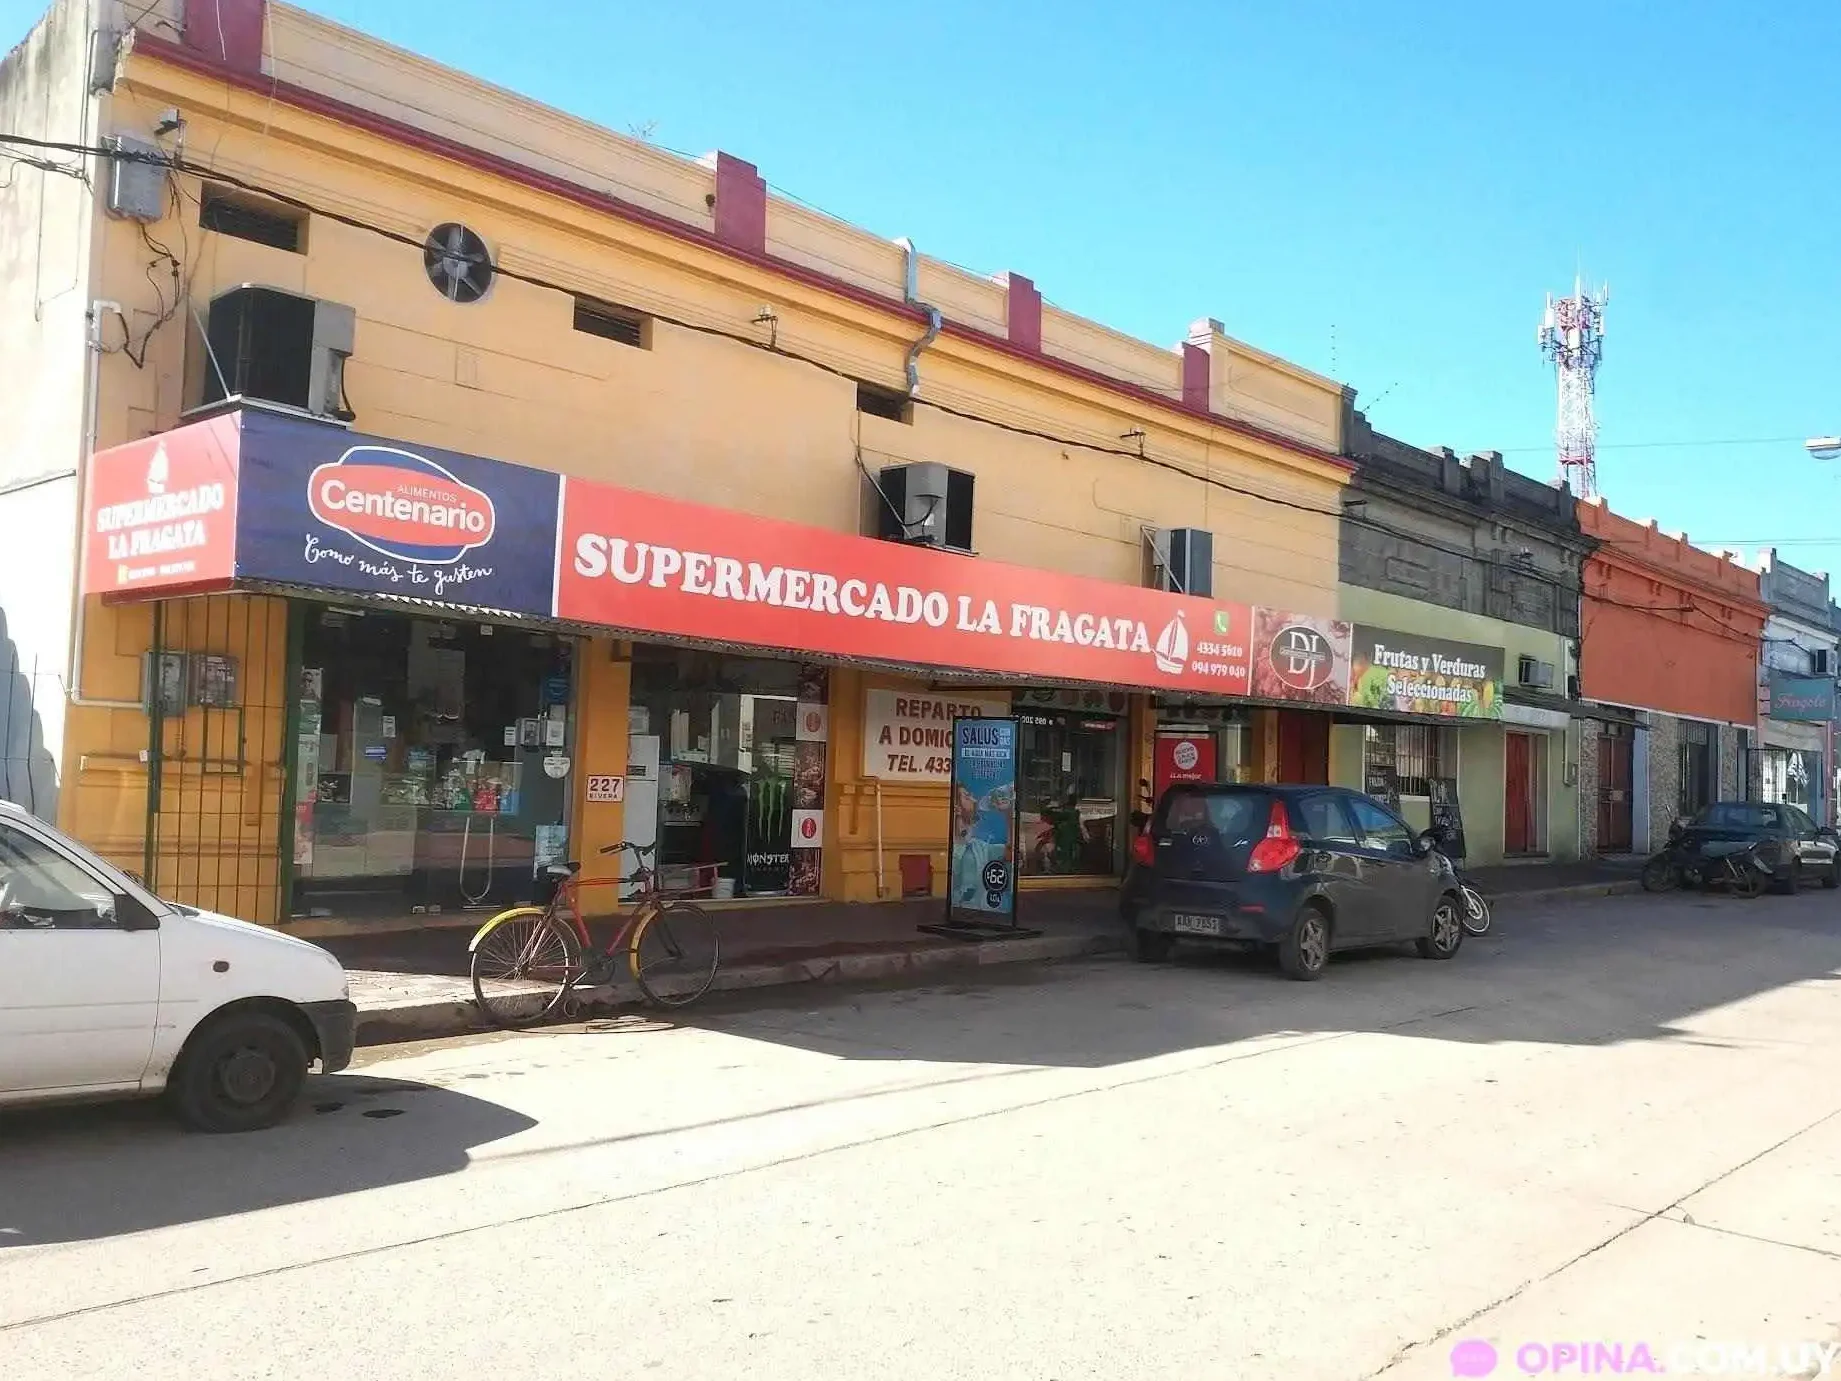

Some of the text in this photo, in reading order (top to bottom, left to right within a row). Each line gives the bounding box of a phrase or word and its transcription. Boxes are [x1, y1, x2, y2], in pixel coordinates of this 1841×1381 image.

[320, 479, 486, 533] Centenario
[396, 484, 458, 503] ALIMENTOS
[97, 483, 223, 532] SUPERMERCADO
[108, 520, 206, 559] LA FRAGATA
[305, 533, 493, 596] Como más te gusten
[574, 533, 1153, 653] SUPERMERCADO LA FRAGATA
[1373, 643, 1486, 679] Frutas y Verduras
[1386, 674, 1472, 703] Seleccionadas
[896, 698, 982, 720] REPARTO
[878, 725, 953, 747] A DOMIC
[962, 727, 999, 746] SALUS
[887, 754, 922, 773] TEL.
[925, 756, 951, 774] 433
[590, 778, 620, 793] 227
[747, 852, 790, 866] MONSTER
